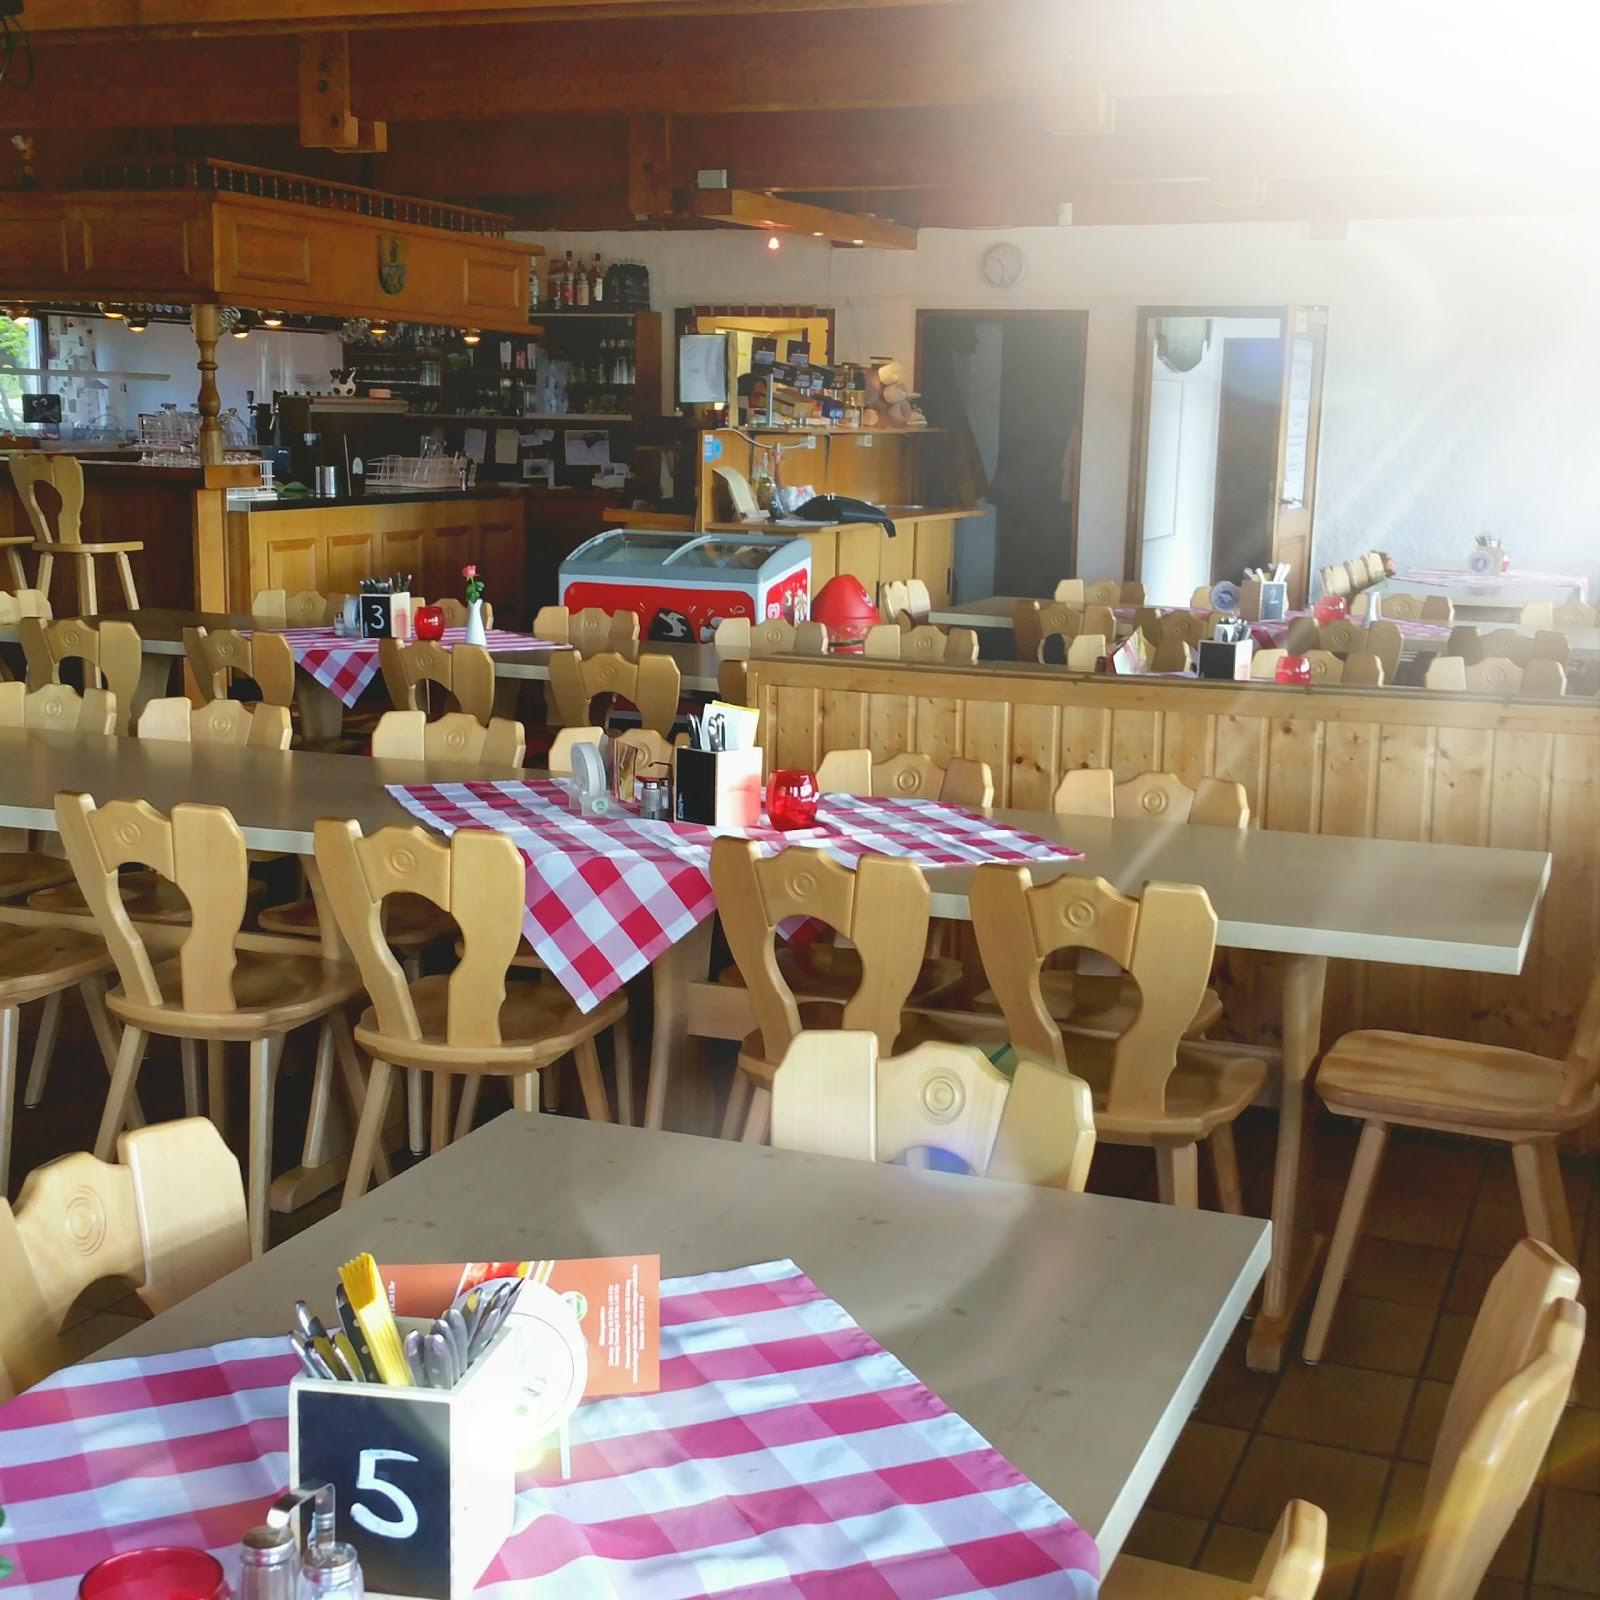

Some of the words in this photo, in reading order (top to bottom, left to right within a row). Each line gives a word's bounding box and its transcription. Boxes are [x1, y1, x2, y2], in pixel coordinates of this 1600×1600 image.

[1269, 589, 1279, 605] 2
[370, 604, 384, 629] 3
[350, 1449, 420, 1539] 5
